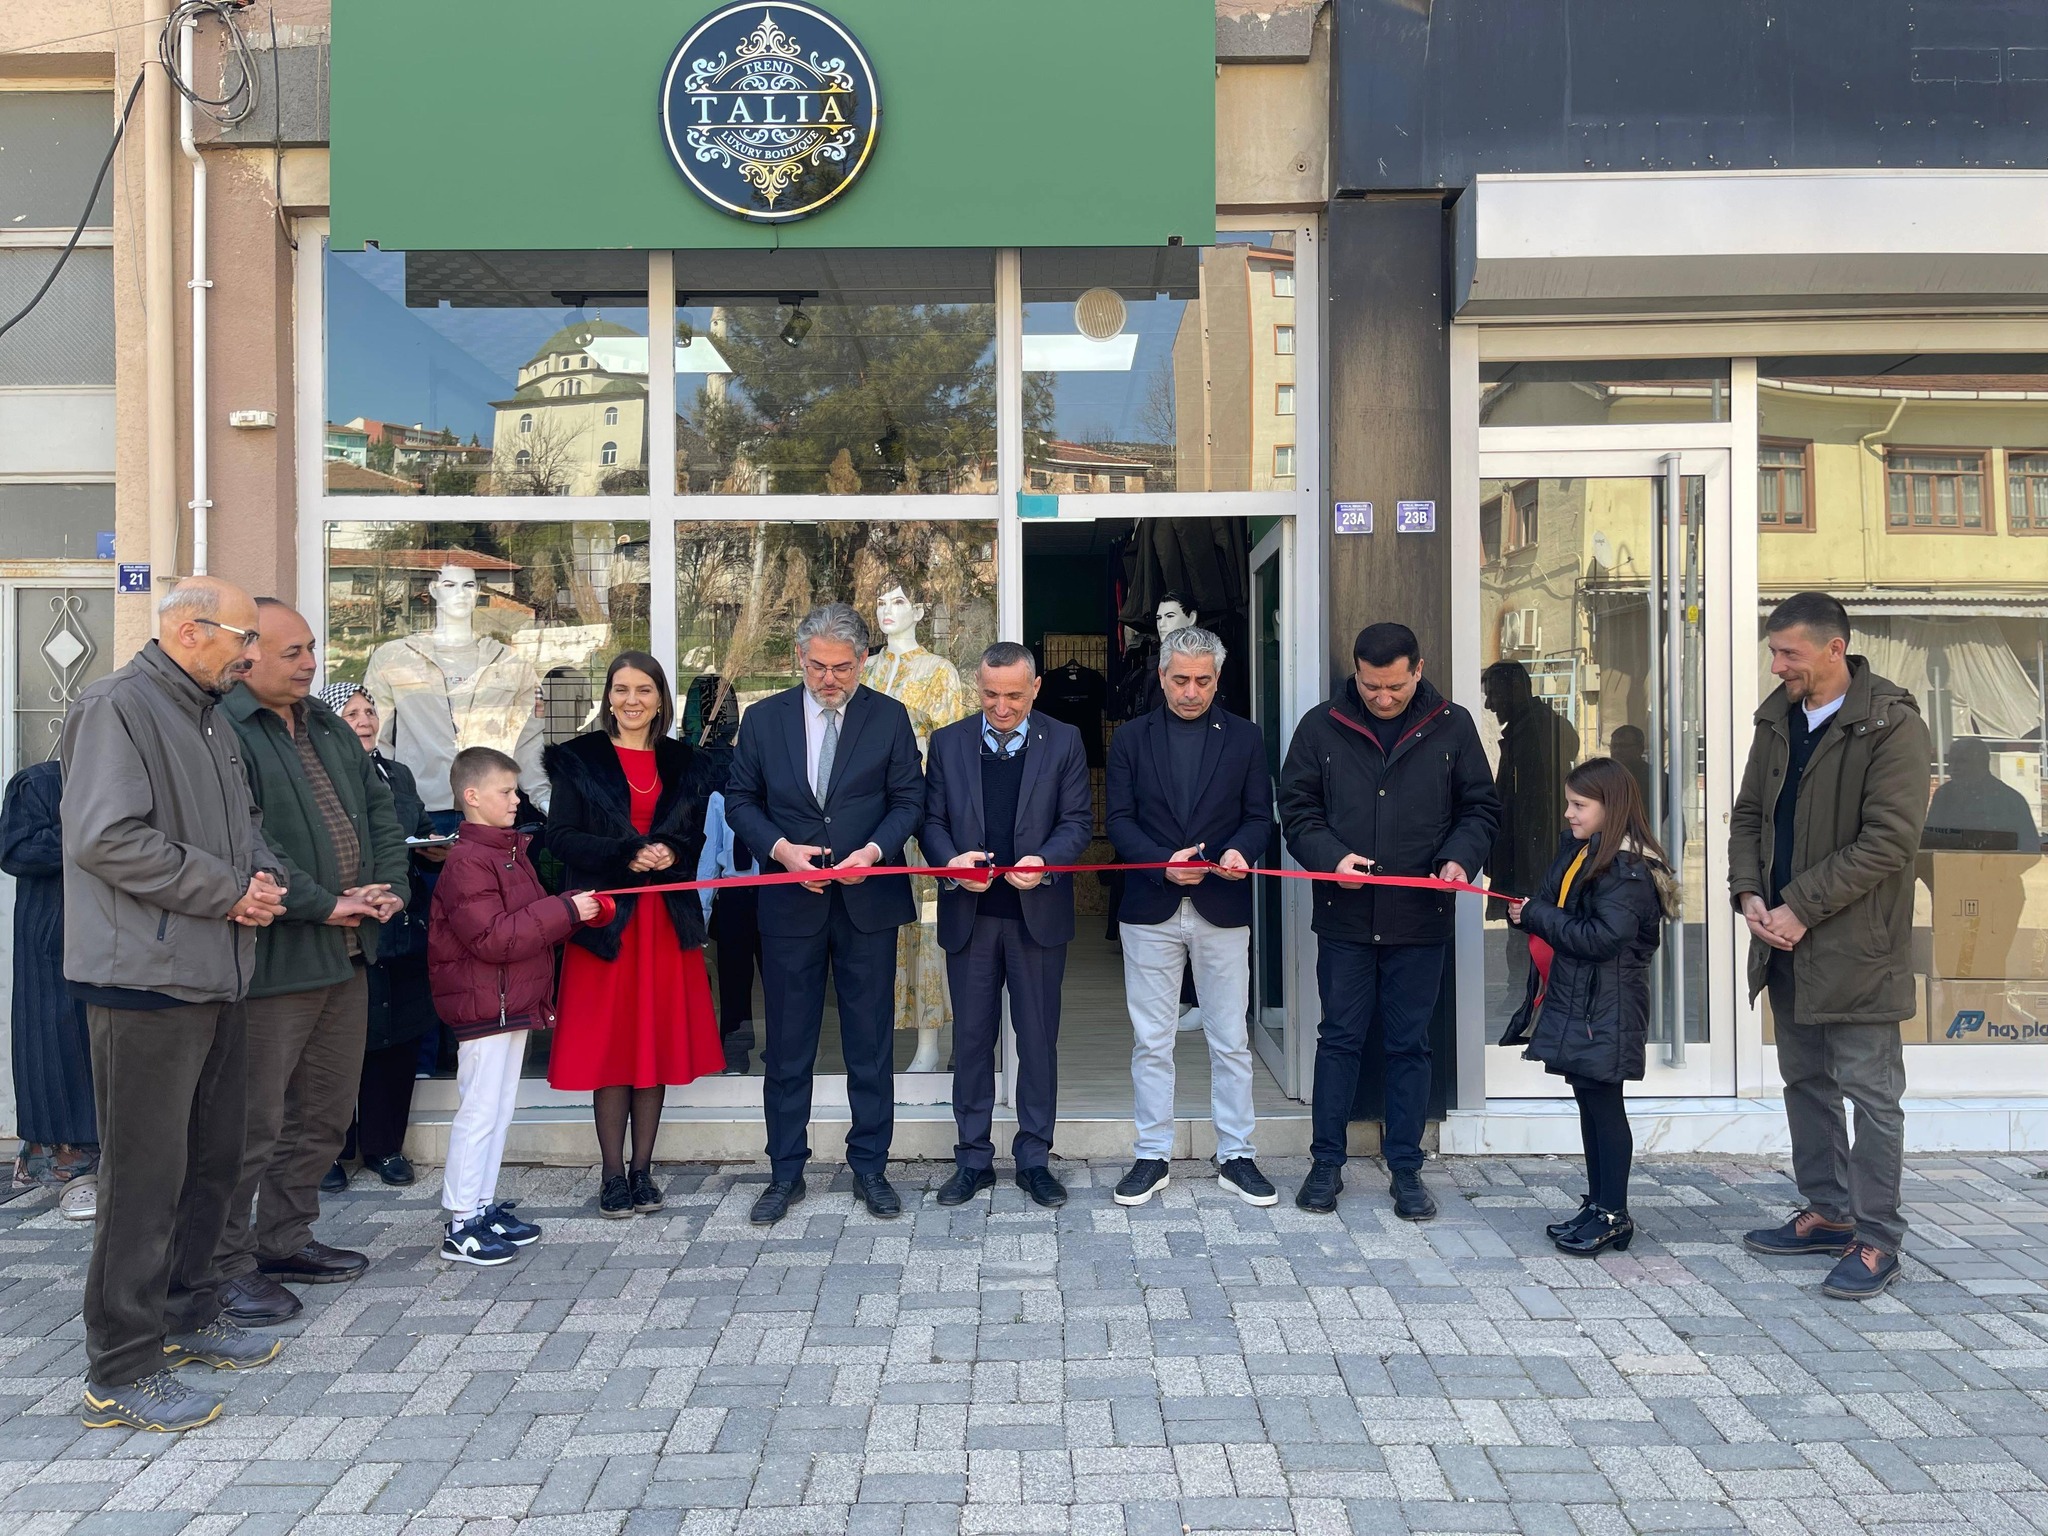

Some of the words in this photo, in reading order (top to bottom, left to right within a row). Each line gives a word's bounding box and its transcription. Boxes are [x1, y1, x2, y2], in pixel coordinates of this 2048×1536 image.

[742, 60, 794, 76] TREND
[691, 95, 846, 124] TALIA
[720, 130, 762, 159] LUXURY
[764, 130, 819, 159] BOUTIQUE
[1342, 512, 1366, 525] 23A
[1404, 511, 1428, 524] 23B
[129, 573, 144, 585] 21
